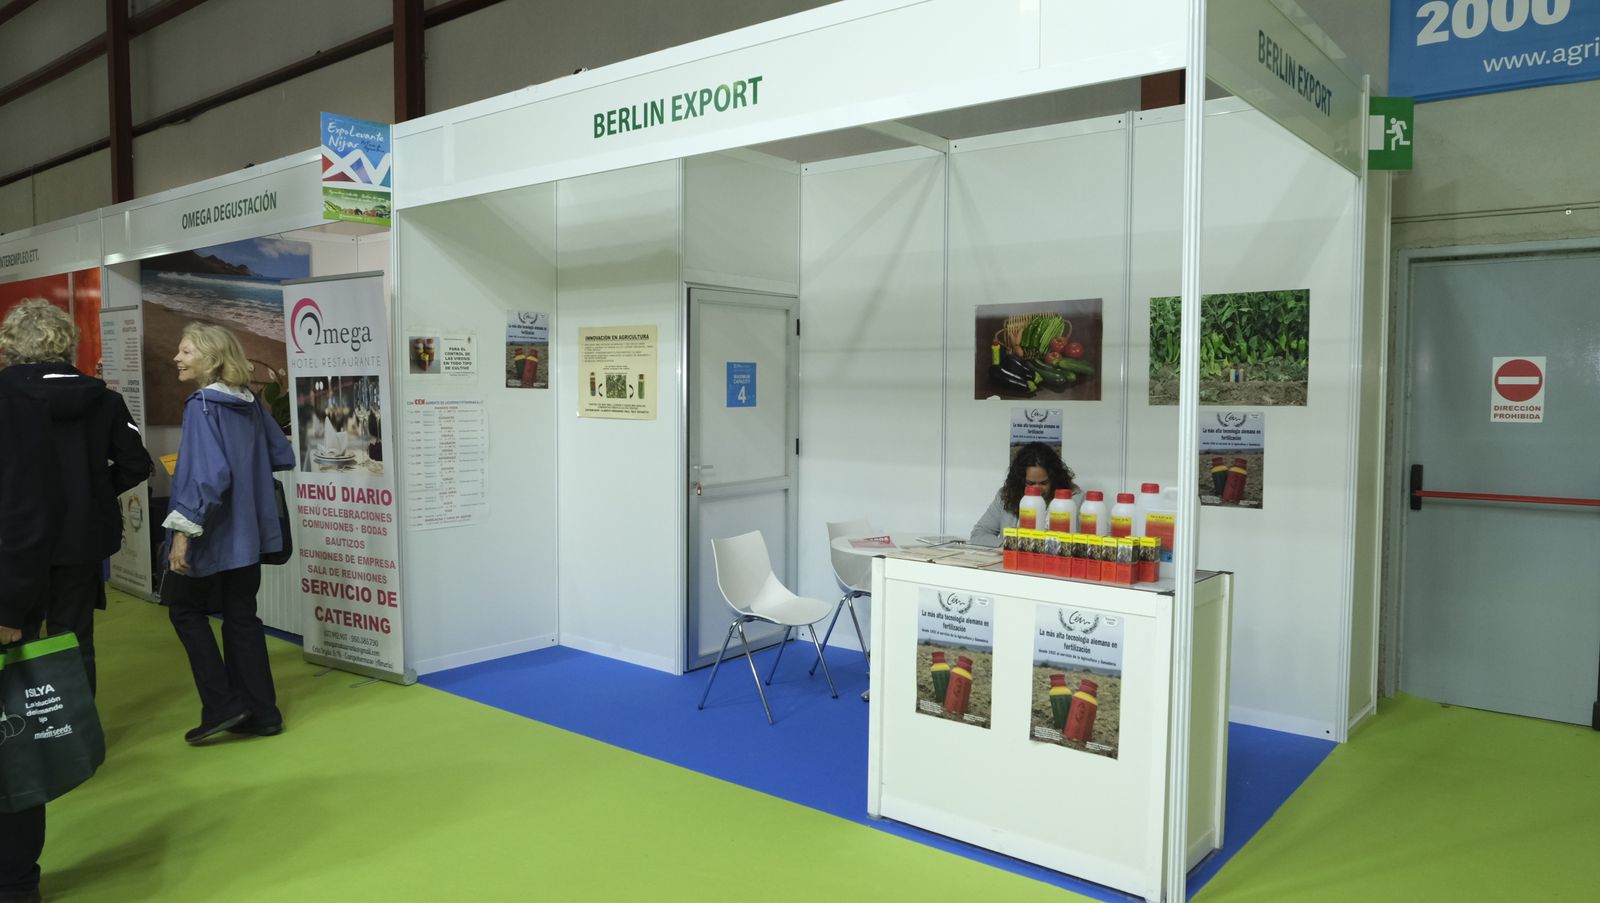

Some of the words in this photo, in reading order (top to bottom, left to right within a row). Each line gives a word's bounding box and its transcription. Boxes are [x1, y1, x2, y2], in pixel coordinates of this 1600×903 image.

[1416, 0, 1571, 47] 2000
[1483, 37, 1600, 72] www.agri
[1258, 29, 1296, 89] BERLIN
[1298, 64, 1332, 117] EXPORT
[594, 99, 664, 139] BERLIN
[672, 76, 763, 122] EXPORT
[182, 211, 212, 230] OMEGA
[214, 190, 277, 224] DEGUSTACIÓN
[292, 358, 318, 369] HOTEL
[322, 356, 381, 368] RESTAURANTE
[738, 386, 747, 403] 4
[296, 482, 336, 501] MENÚ
[341, 486, 392, 506] DIARIO
[297, 504, 320, 516] MENÚ
[322, 507, 392, 523] CELEBRACIONES
[303, 519, 354, 532] COMUNIONES
[361, 525, 387, 537] BODAS
[326, 537, 366, 549] BAUTIZOS
[300, 549, 343, 562] REUNIONES
[346, 555, 355, 564] DE
[358, 556, 396, 570] EMPRESA
[308, 565, 327, 576] SALA
[329, 567, 340, 577] DE
[342, 569, 387, 584] REUNIONES
[302, 578, 372, 603] SERVICIO
[377, 589, 398, 608] DE
[315, 606, 391, 635] CATERING
[1040, 628, 1045, 636] La
[1091, 638, 1110, 648] alemana
[25, 684, 55, 698] ISLYA
